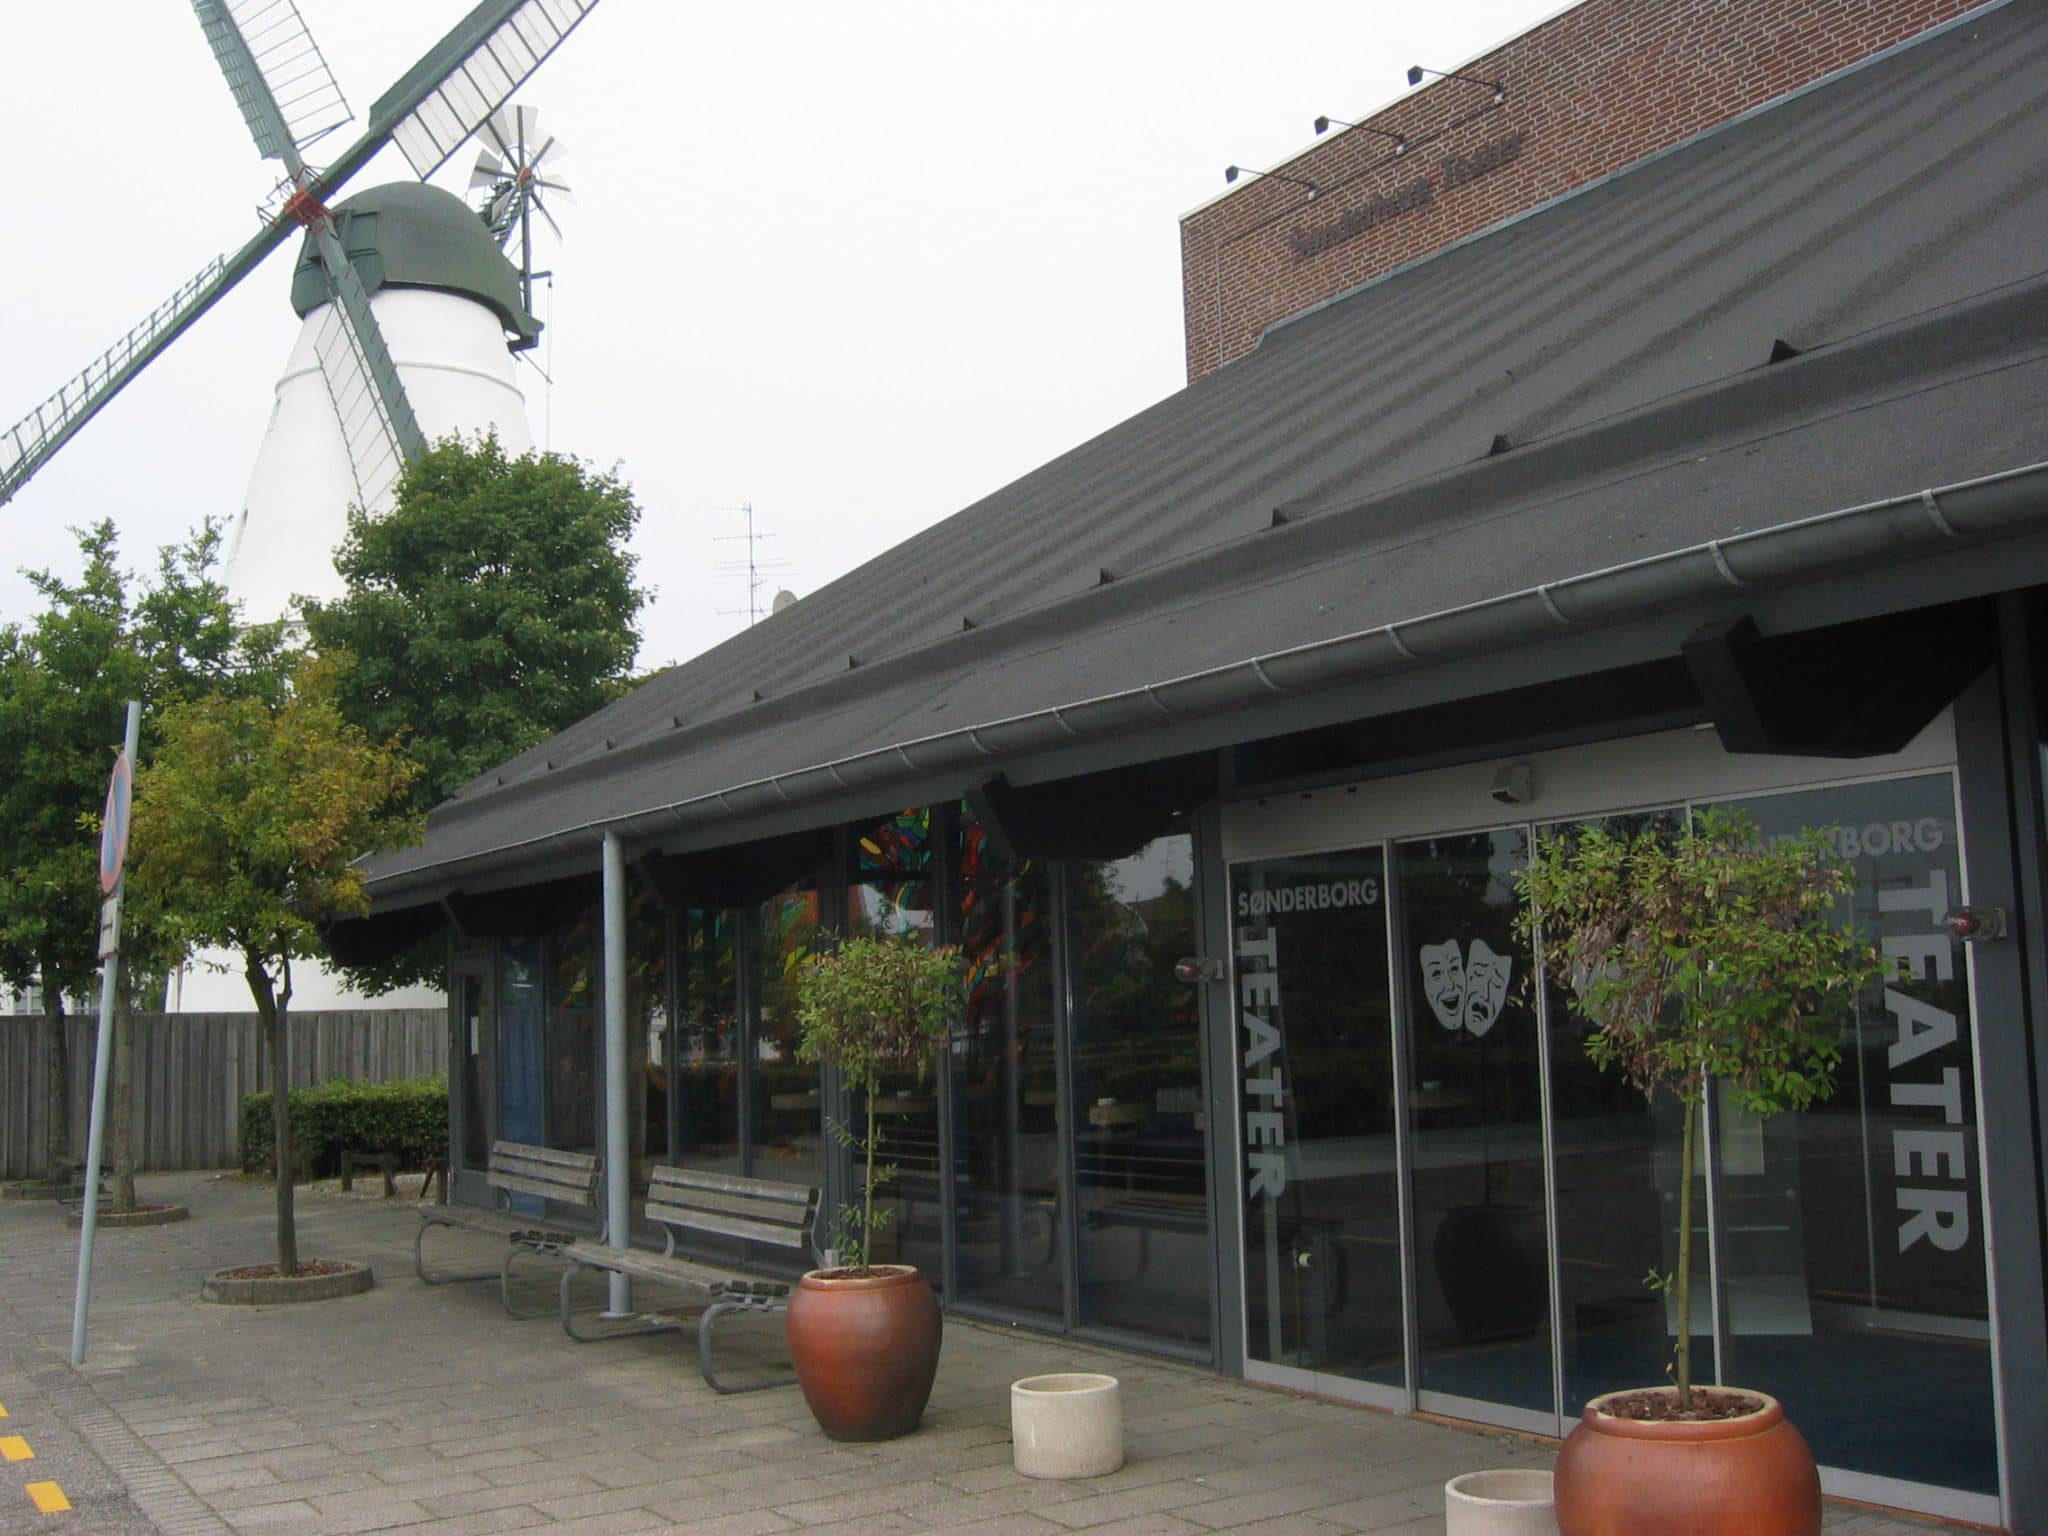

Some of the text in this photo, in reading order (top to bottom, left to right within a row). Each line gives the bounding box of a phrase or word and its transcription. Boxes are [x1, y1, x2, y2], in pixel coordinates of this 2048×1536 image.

[1238, 878, 1378, 917] SØNDERBORG
[1708, 816, 1944, 868] RBORG
[1238, 926, 1286, 1200] TEATER
[1877, 868, 1969, 1255] TEATER
